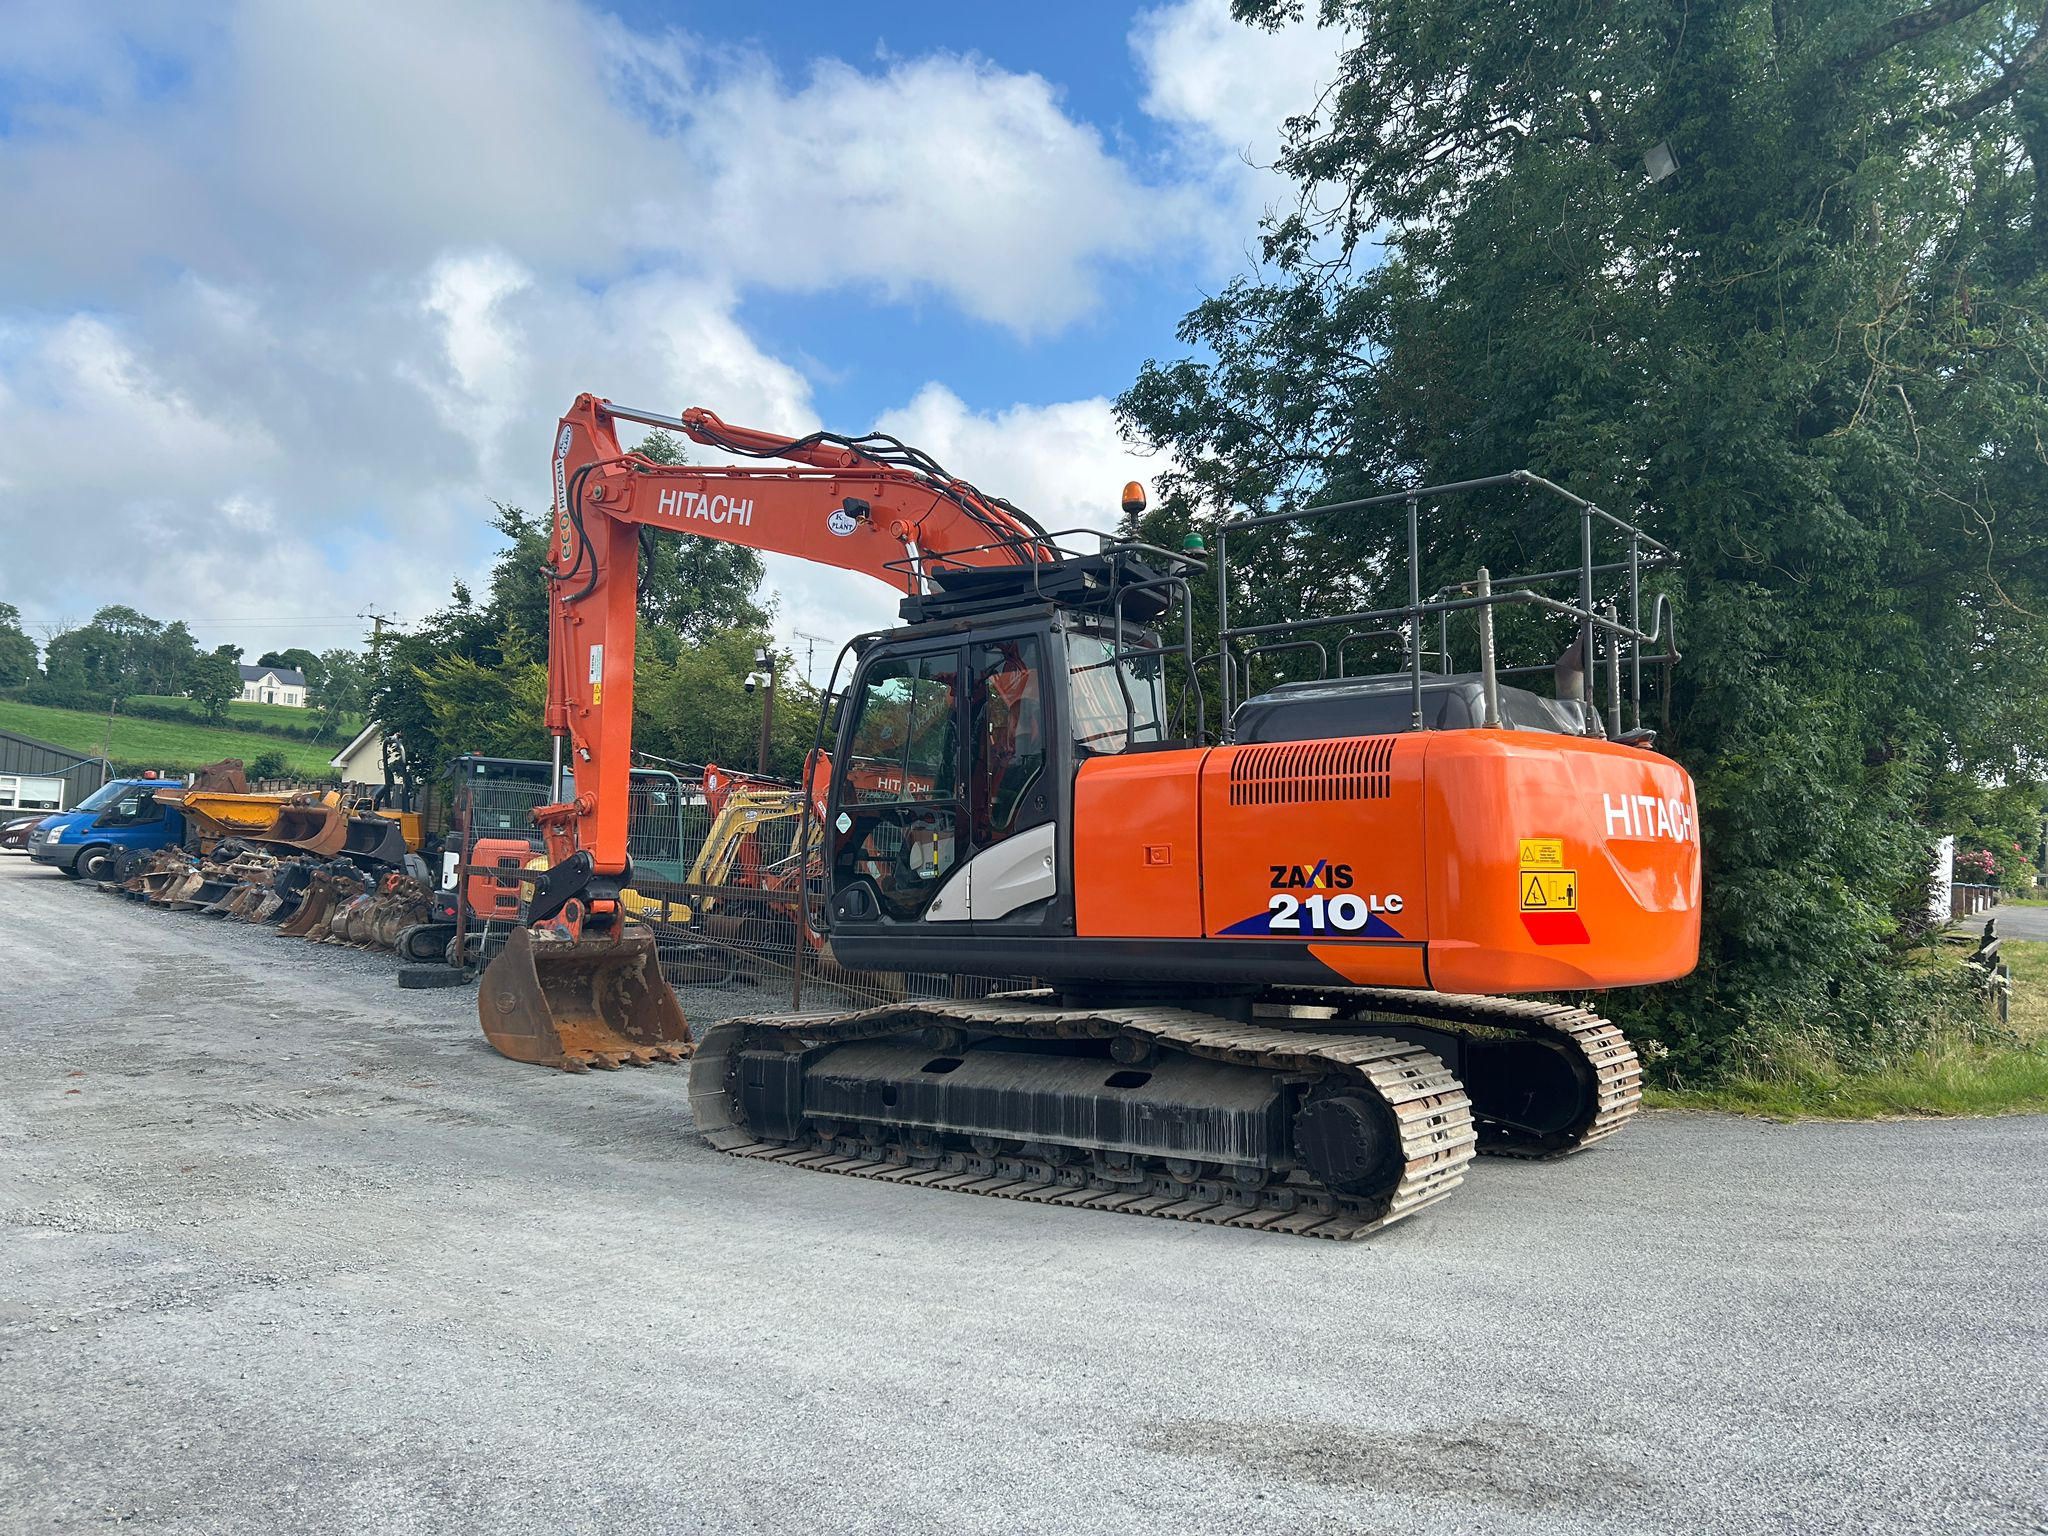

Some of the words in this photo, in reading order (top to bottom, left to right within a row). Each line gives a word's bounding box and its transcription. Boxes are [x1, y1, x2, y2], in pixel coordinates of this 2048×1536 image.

[562, 430, 571, 454] PLANT
[557, 461, 566, 509] HITACHI
[658, 488, 753, 526] HITACHI
[560, 513, 572, 559] eco
[832, 522, 853, 530] PLANT
[878, 777, 930, 793] HITCHI
[1269, 859, 1354, 889] ZAXIS
